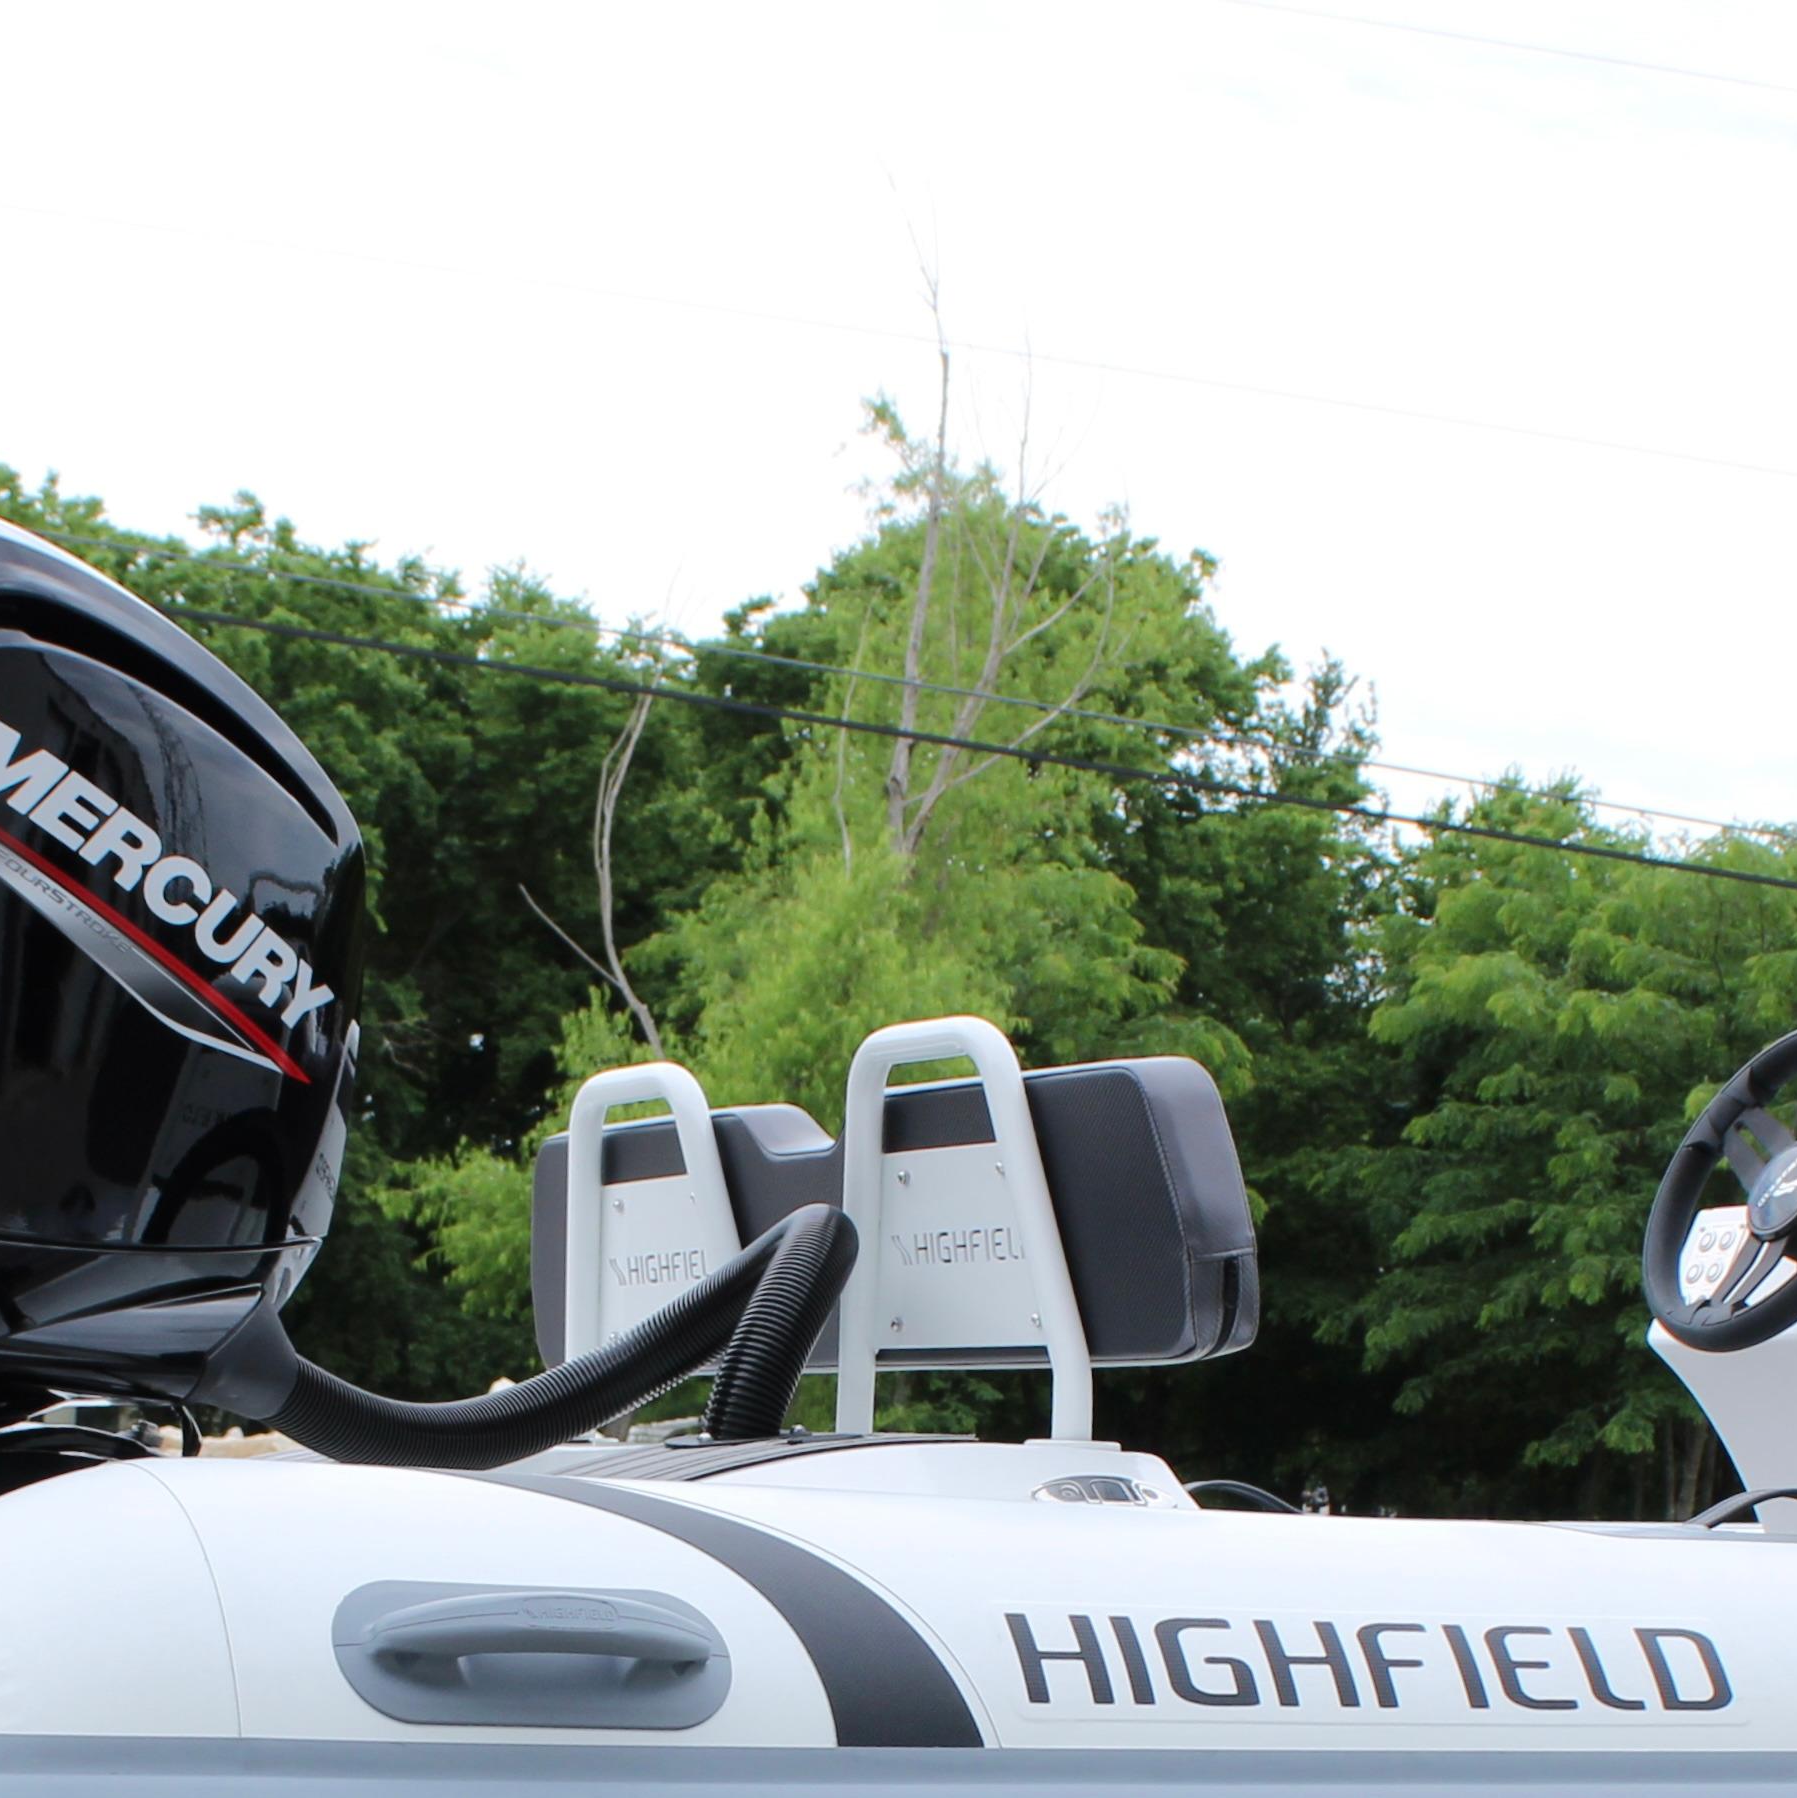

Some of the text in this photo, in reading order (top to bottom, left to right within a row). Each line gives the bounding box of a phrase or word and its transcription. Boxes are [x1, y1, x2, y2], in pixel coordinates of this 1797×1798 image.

[913, 1227, 1026, 1265] HIGHFIEL
[626, 1249, 710, 1286] HIGHFIEL
[1003, 1612, 1733, 1712] HIGHFIELD
